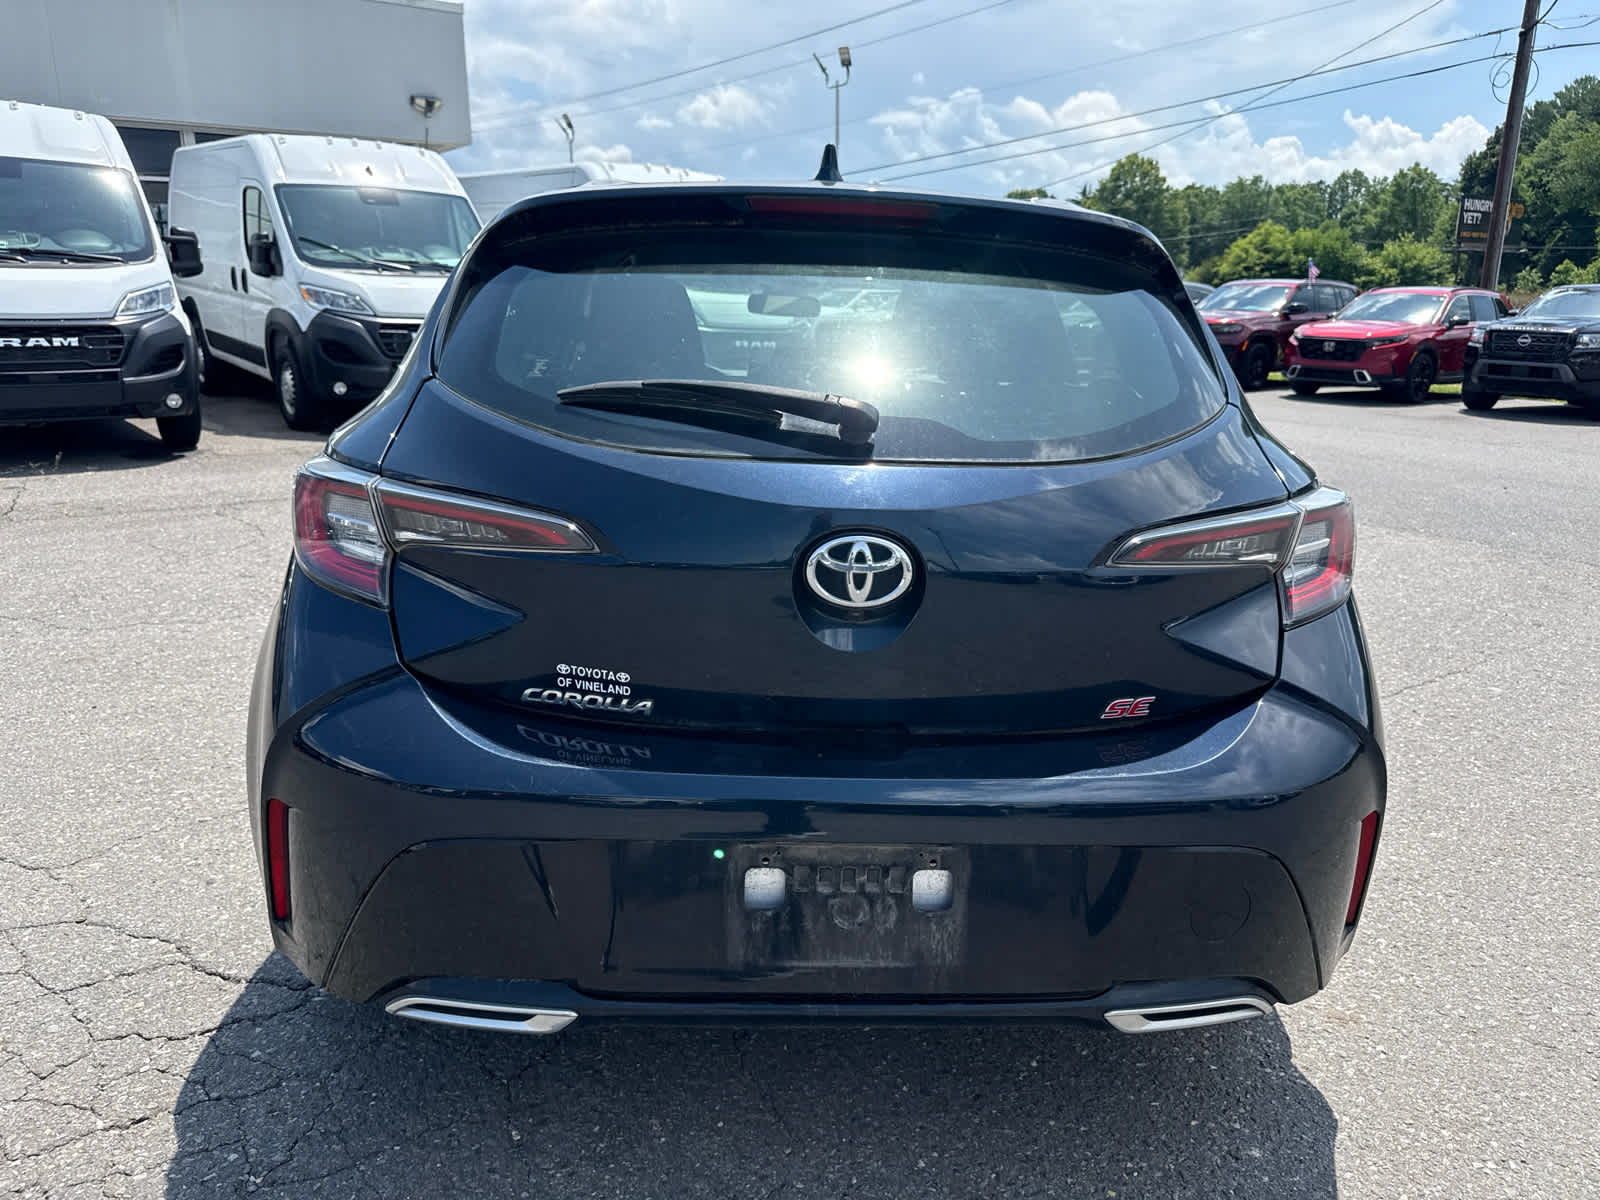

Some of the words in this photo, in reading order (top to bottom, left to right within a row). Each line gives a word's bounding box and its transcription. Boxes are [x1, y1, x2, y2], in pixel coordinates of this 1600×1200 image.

[1463, 211, 1482, 224] YET?
[0, 337, 79, 347] RAM
[570, 665, 616, 681] TOYOTA
[557, 677, 573, 687] OF
[574, 679, 631, 696] VINELAND
[520, 687, 654, 715] COROLLA
[1100, 696, 1156, 719] SE
